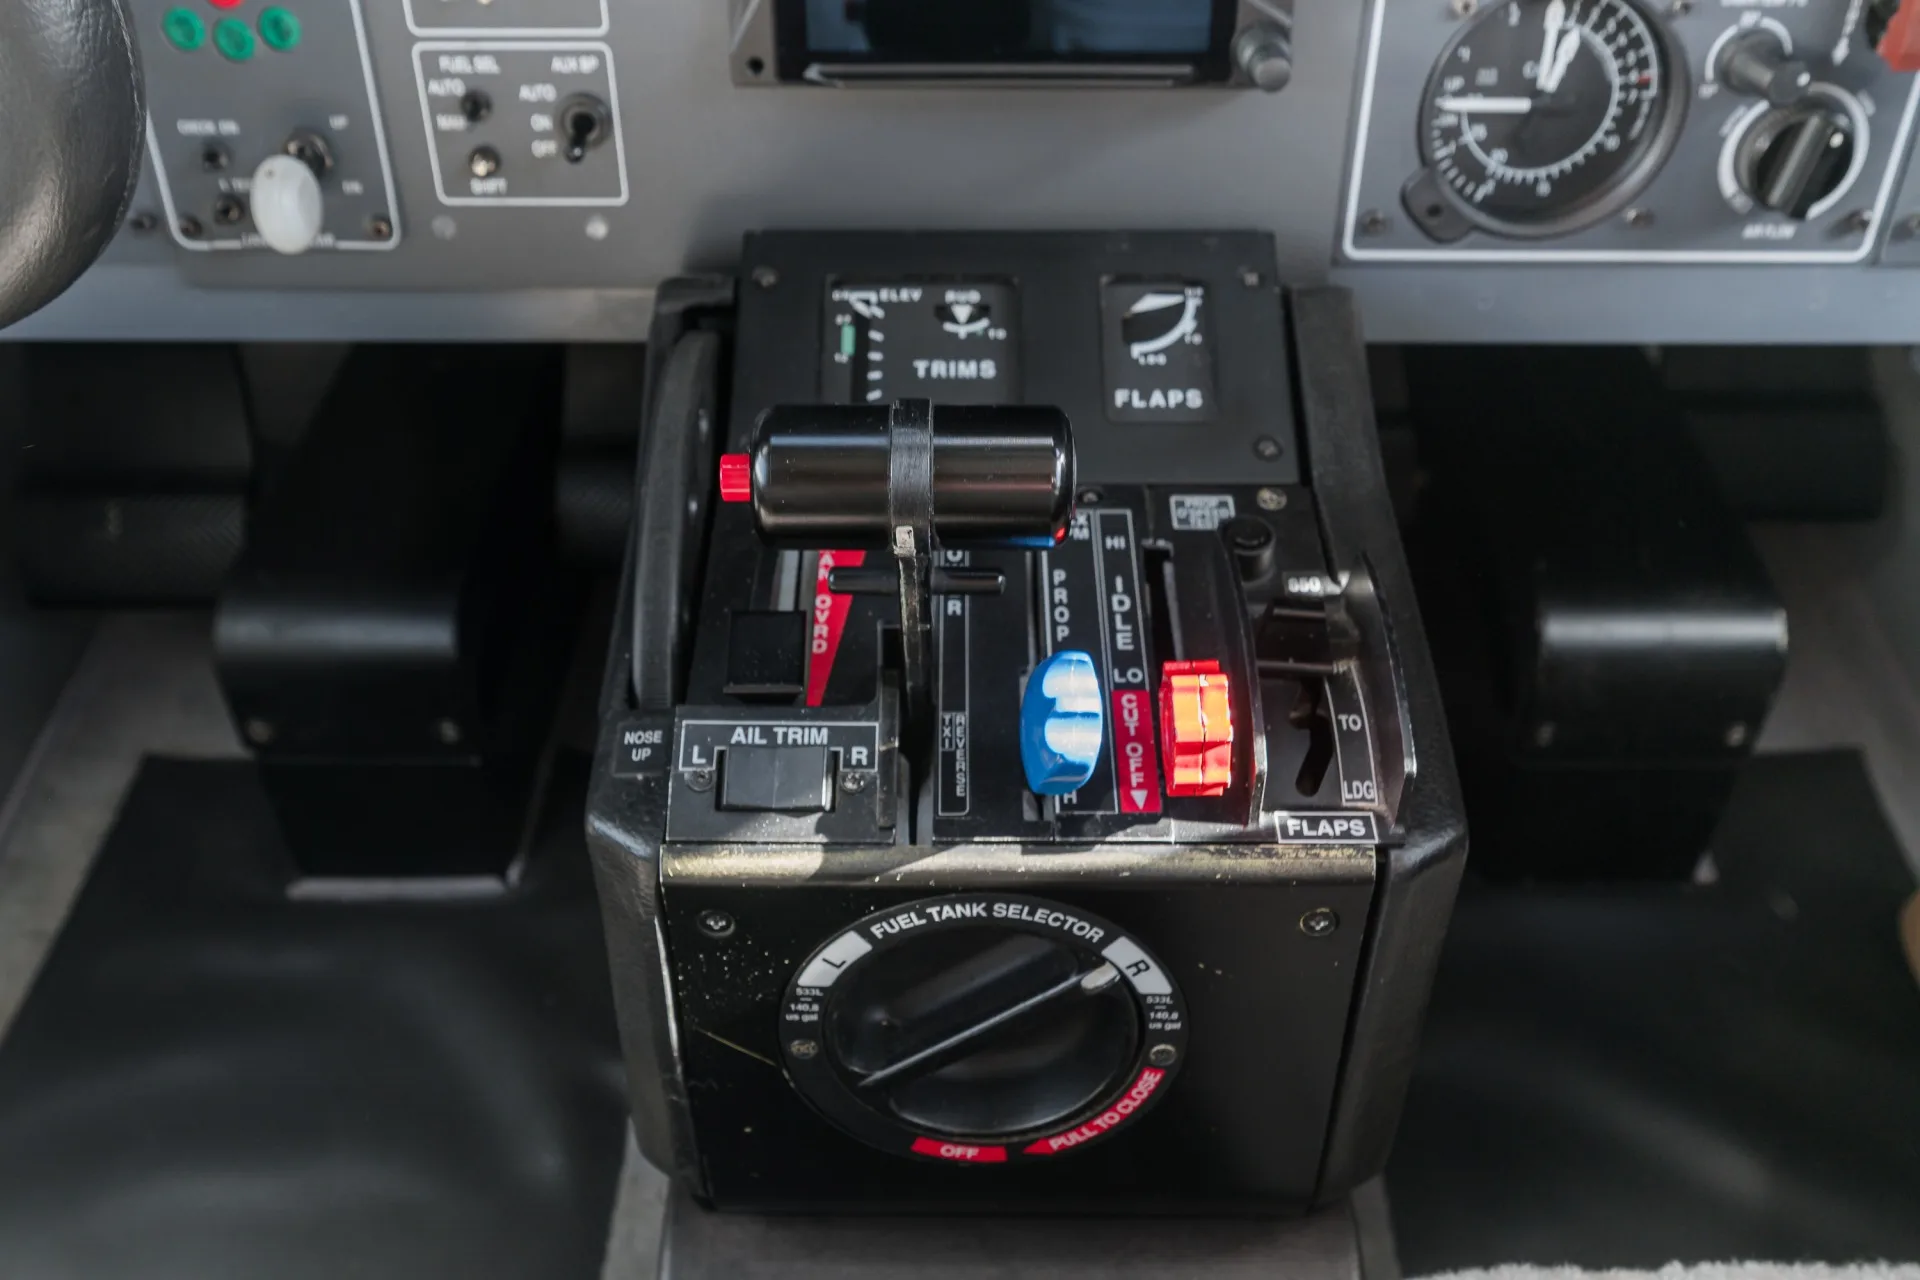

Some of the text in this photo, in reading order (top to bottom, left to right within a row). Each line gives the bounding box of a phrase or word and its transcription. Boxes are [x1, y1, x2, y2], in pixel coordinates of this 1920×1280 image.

[519, 83, 557, 102] AUTO
[879, 288, 922, 302] ELEV
[912, 359, 997, 380] TRIMS
[1114, 388, 1203, 409] FLAPS
[1105, 535, 1126, 550] HI
[1053, 568, 1070, 642] PROP
[1111, 575, 1135, 650] IDLE
[812, 594, 832, 654] OVRD
[1113, 668, 1144, 683] LO
[1338, 714, 1362, 731] TO
[624, 730, 662, 745] NOSE
[731, 727, 828, 745] AIL TRIM
[1121, 694, 1144, 787] CUT OFF
[631, 748, 651, 761] UP
[692, 748, 706, 763] L
[851, 748, 868, 765] R
[956, 714, 966, 797] REVERSE
[1344, 781, 1375, 799] LDG
[1287, 819, 1366, 836] FLAPS
[870, 902, 1105, 943] FUEL TANK SELECTOR
[822, 958, 847, 968] L
[1125, 959, 1150, 977] R
[1048, 1070, 1162, 1151] PULL TO CLOSE
[940, 1144, 980, 1159] OFF
